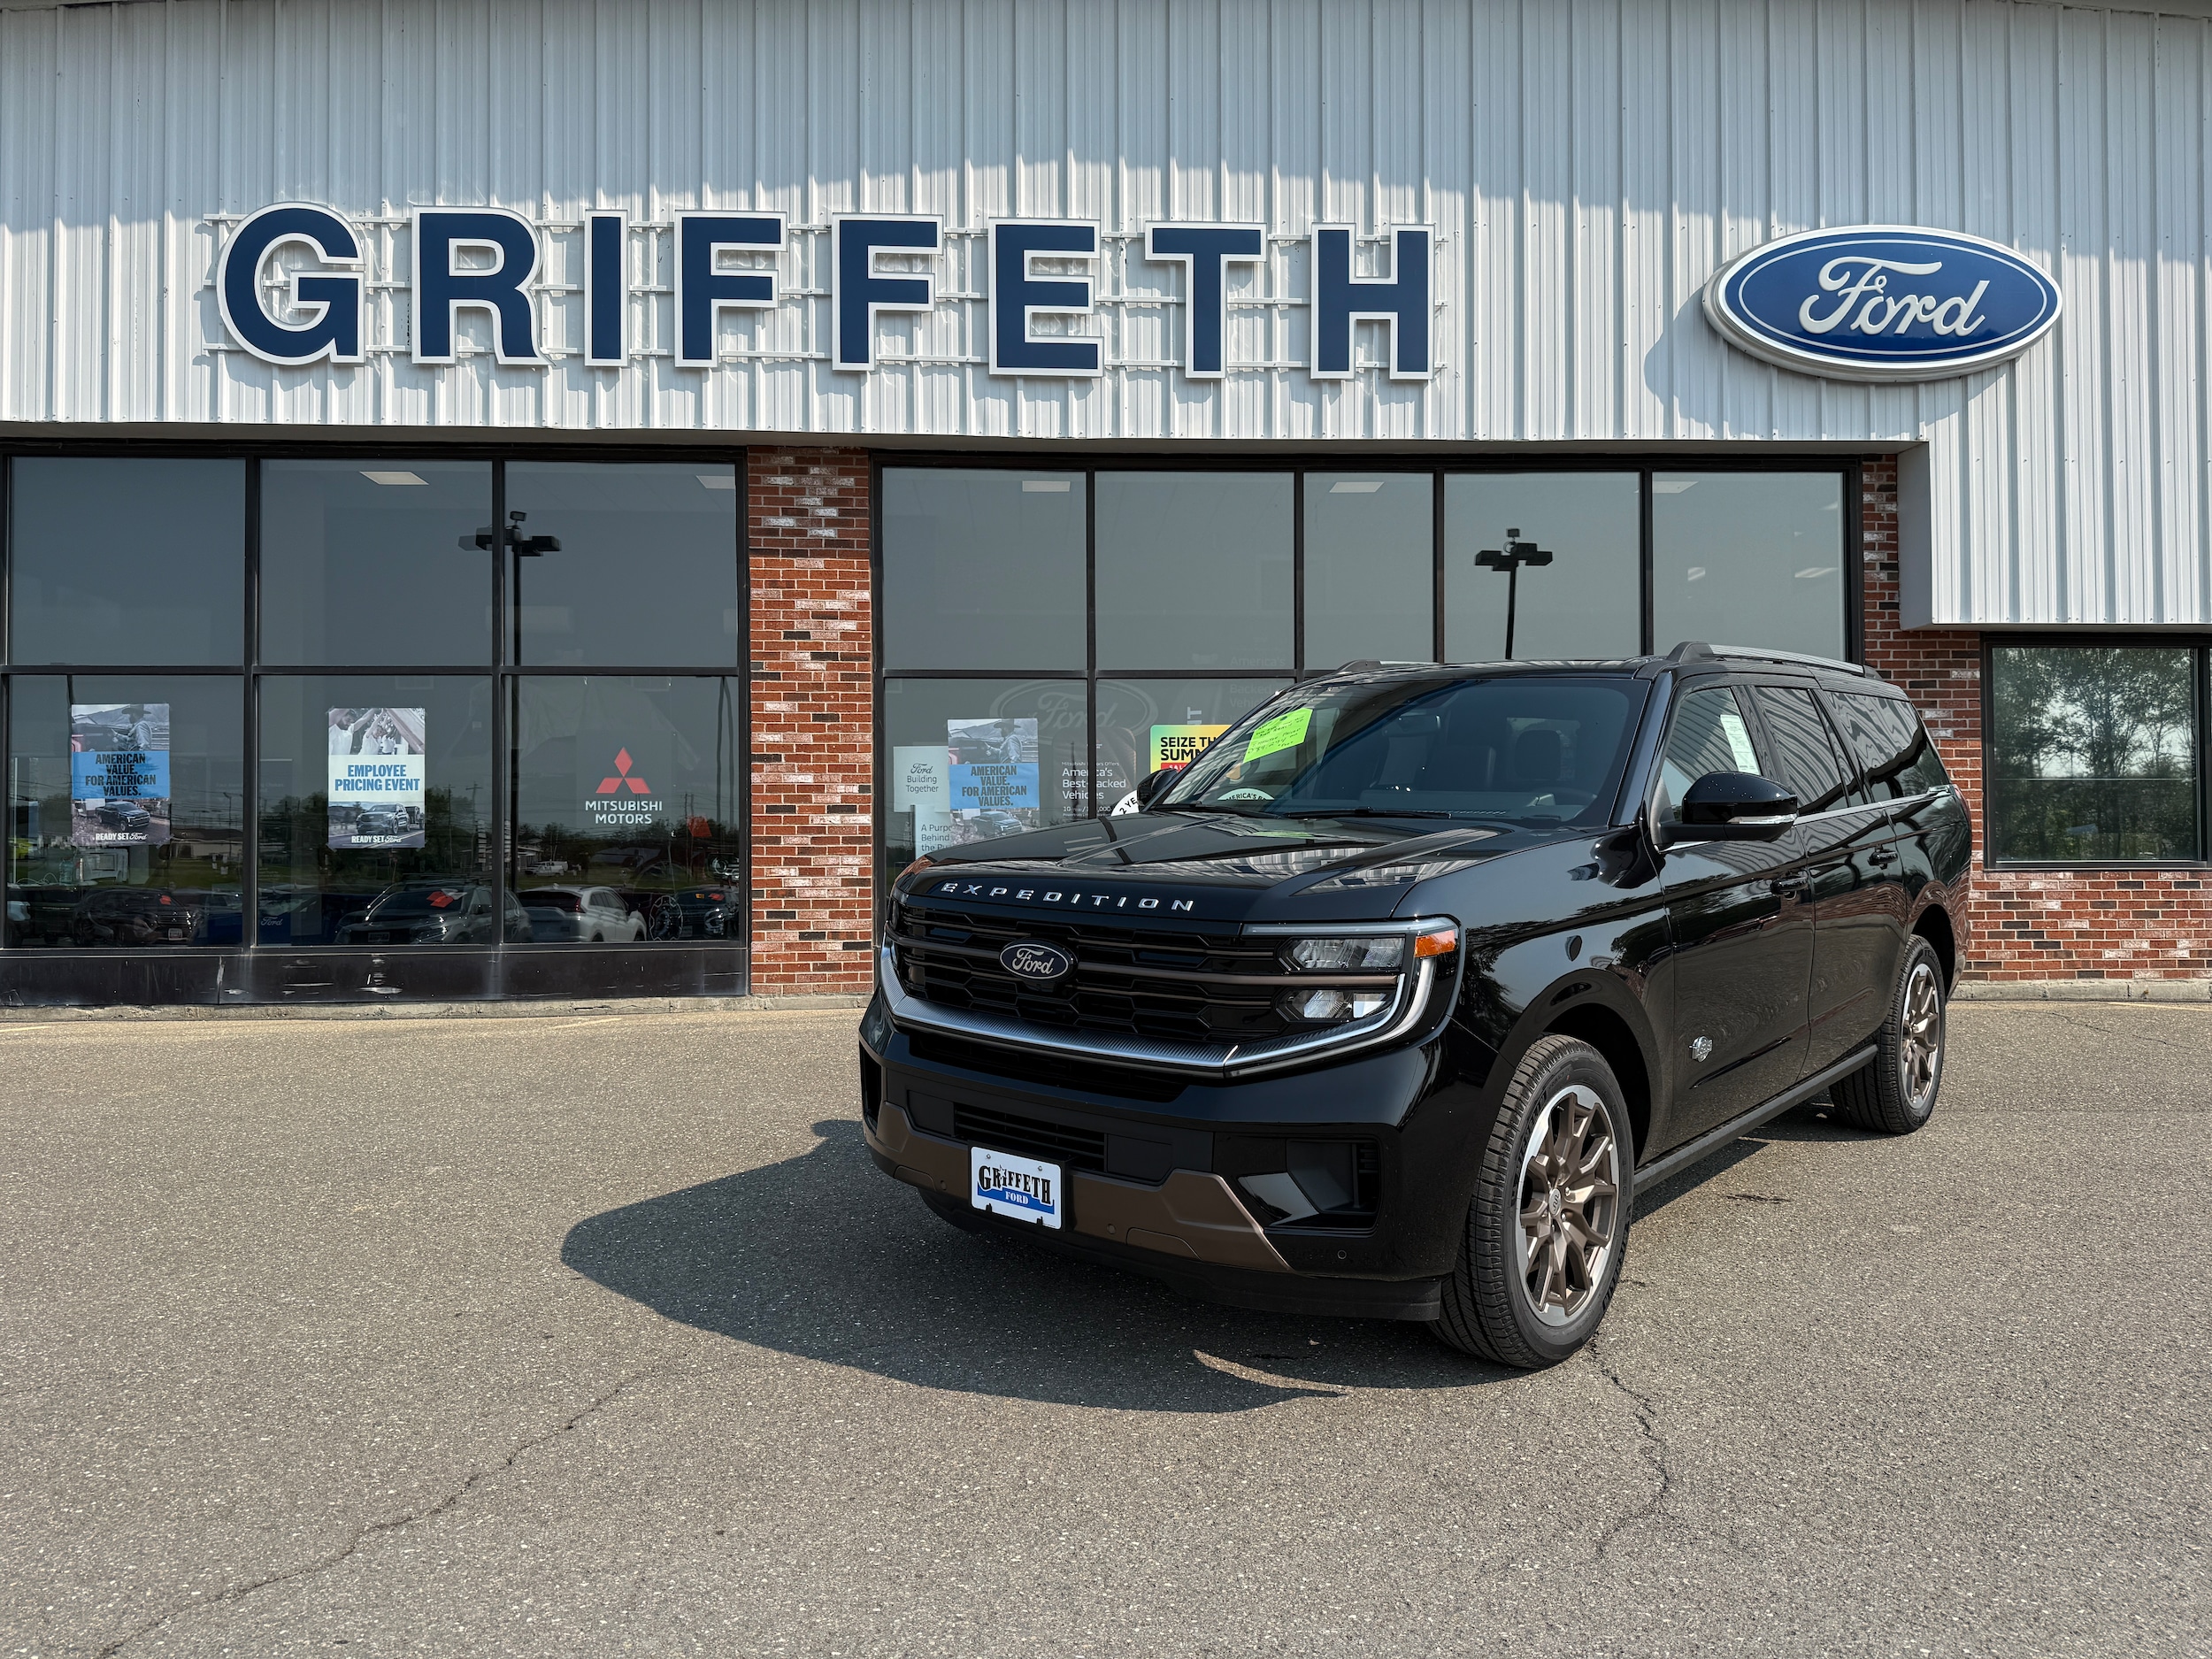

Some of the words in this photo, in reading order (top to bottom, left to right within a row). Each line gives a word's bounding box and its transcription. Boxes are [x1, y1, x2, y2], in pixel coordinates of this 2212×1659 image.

[217, 202, 1434, 380] GRIFFETH
[1799, 256, 1990, 337] Ford
[1161, 737, 1196, 748] SEIZE
[1199, 737, 1217, 748] TH
[96, 753, 146, 764] AMERICAN
[1161, 749, 1202, 761] SUM
[106, 764, 138, 775] VALUE.
[348, 764, 407, 777] EMPLOYEE
[910, 763, 933, 774] Ford
[971, 765, 1017, 776] AMERICAN
[1062, 767, 1113, 777] Ameca's
[85, 775, 104, 786] FOR
[106, 774, 157, 786] AMERICAN
[334, 779, 383, 791] PRICING
[385, 779, 420, 791] EVENT
[907, 775, 937, 785] Building
[980, 776, 1010, 786] VALUE.
[1063, 779, 1126, 788] Best-acked
[103, 786, 142, 796] VALUES.
[906, 785, 939, 795] Together
[962, 787, 979, 796] FOR
[980, 786, 1027, 796] AMERICAN
[1062, 790, 1104, 800] Vehics
[585, 800, 663, 811] MITSUBISHI
[978, 796, 1013, 806] VALUES.
[1125, 797, 1137, 808] YE
[595, 814, 652, 824] MOTORS
[929, 824, 951, 833] Purpo
[941, 882, 1194, 911] EXPEDITION
[260, 916, 283, 926] Ford
[1012, 948, 1055, 975] Ford
[1005, 1191, 1029, 1204] FORD
